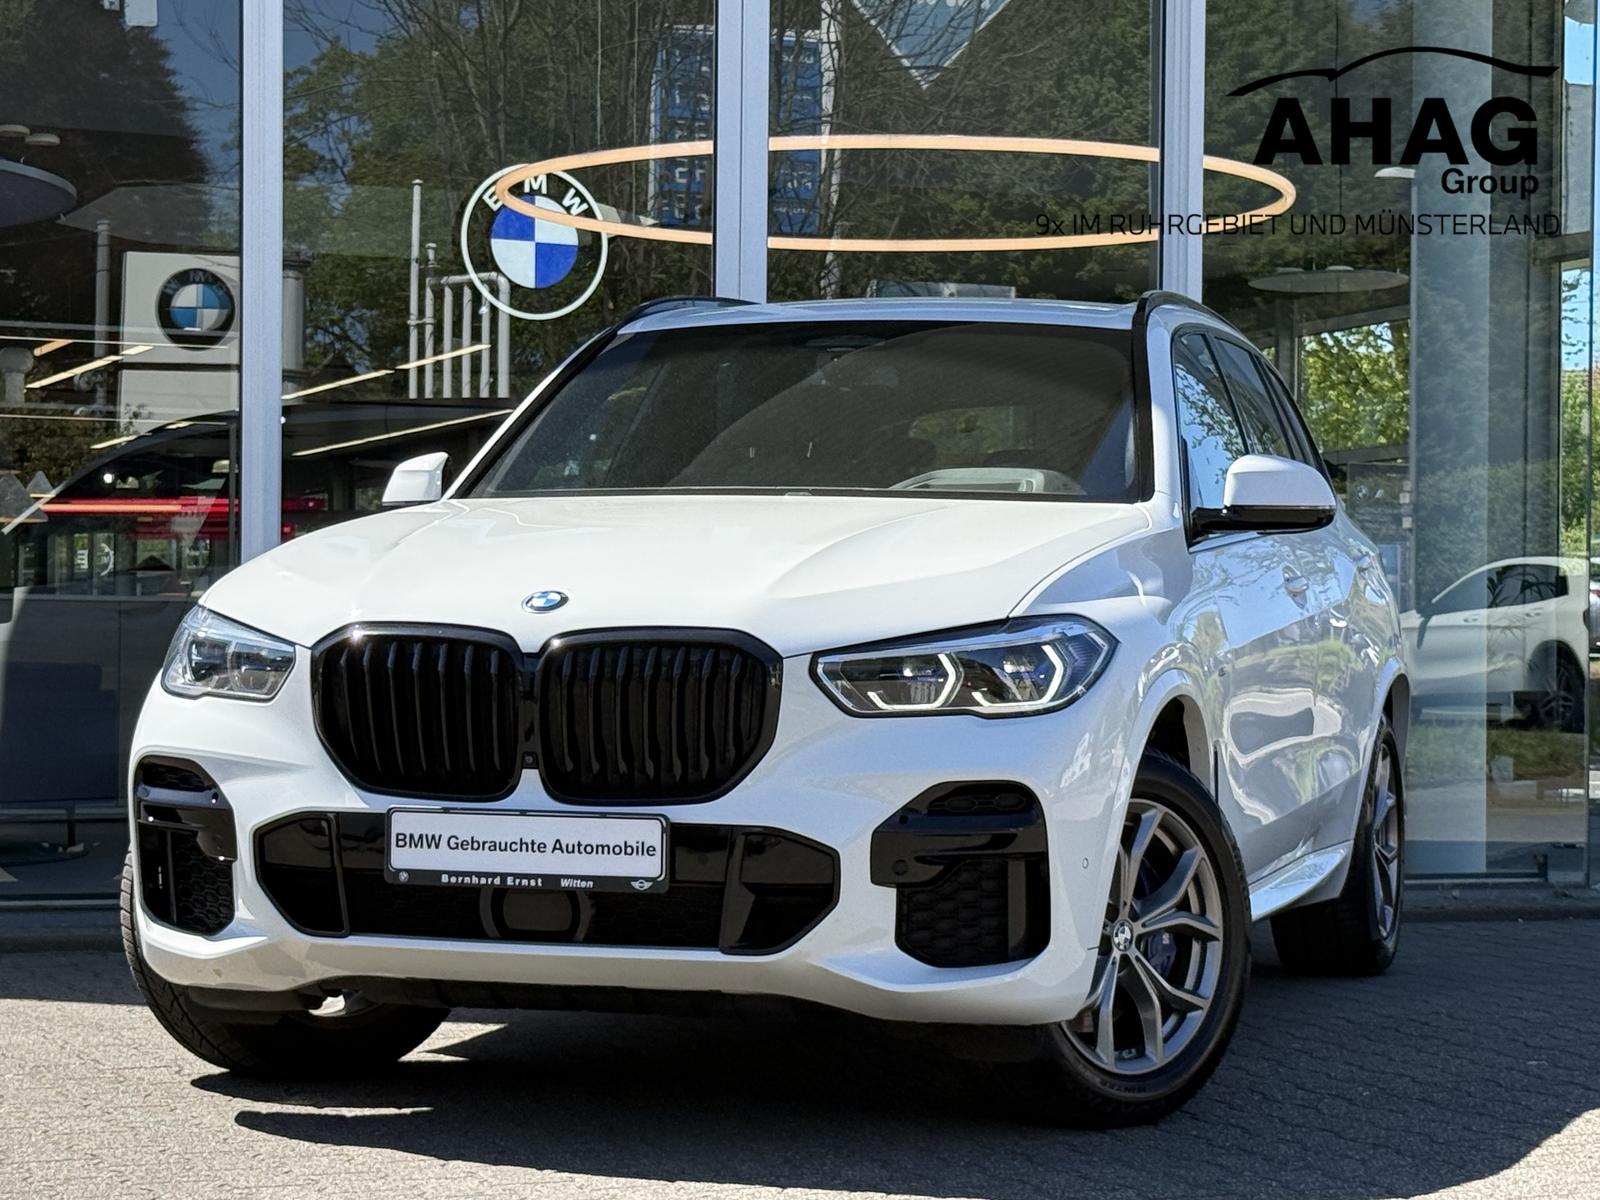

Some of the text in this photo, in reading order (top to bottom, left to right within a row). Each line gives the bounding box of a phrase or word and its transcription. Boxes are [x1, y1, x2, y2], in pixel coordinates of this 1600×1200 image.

[395, 832, 656, 857] BMW Gebrauchte Automobile
[441, 873, 543, 887] Bernhard Ernst
[560, 878, 594, 889] Witten
